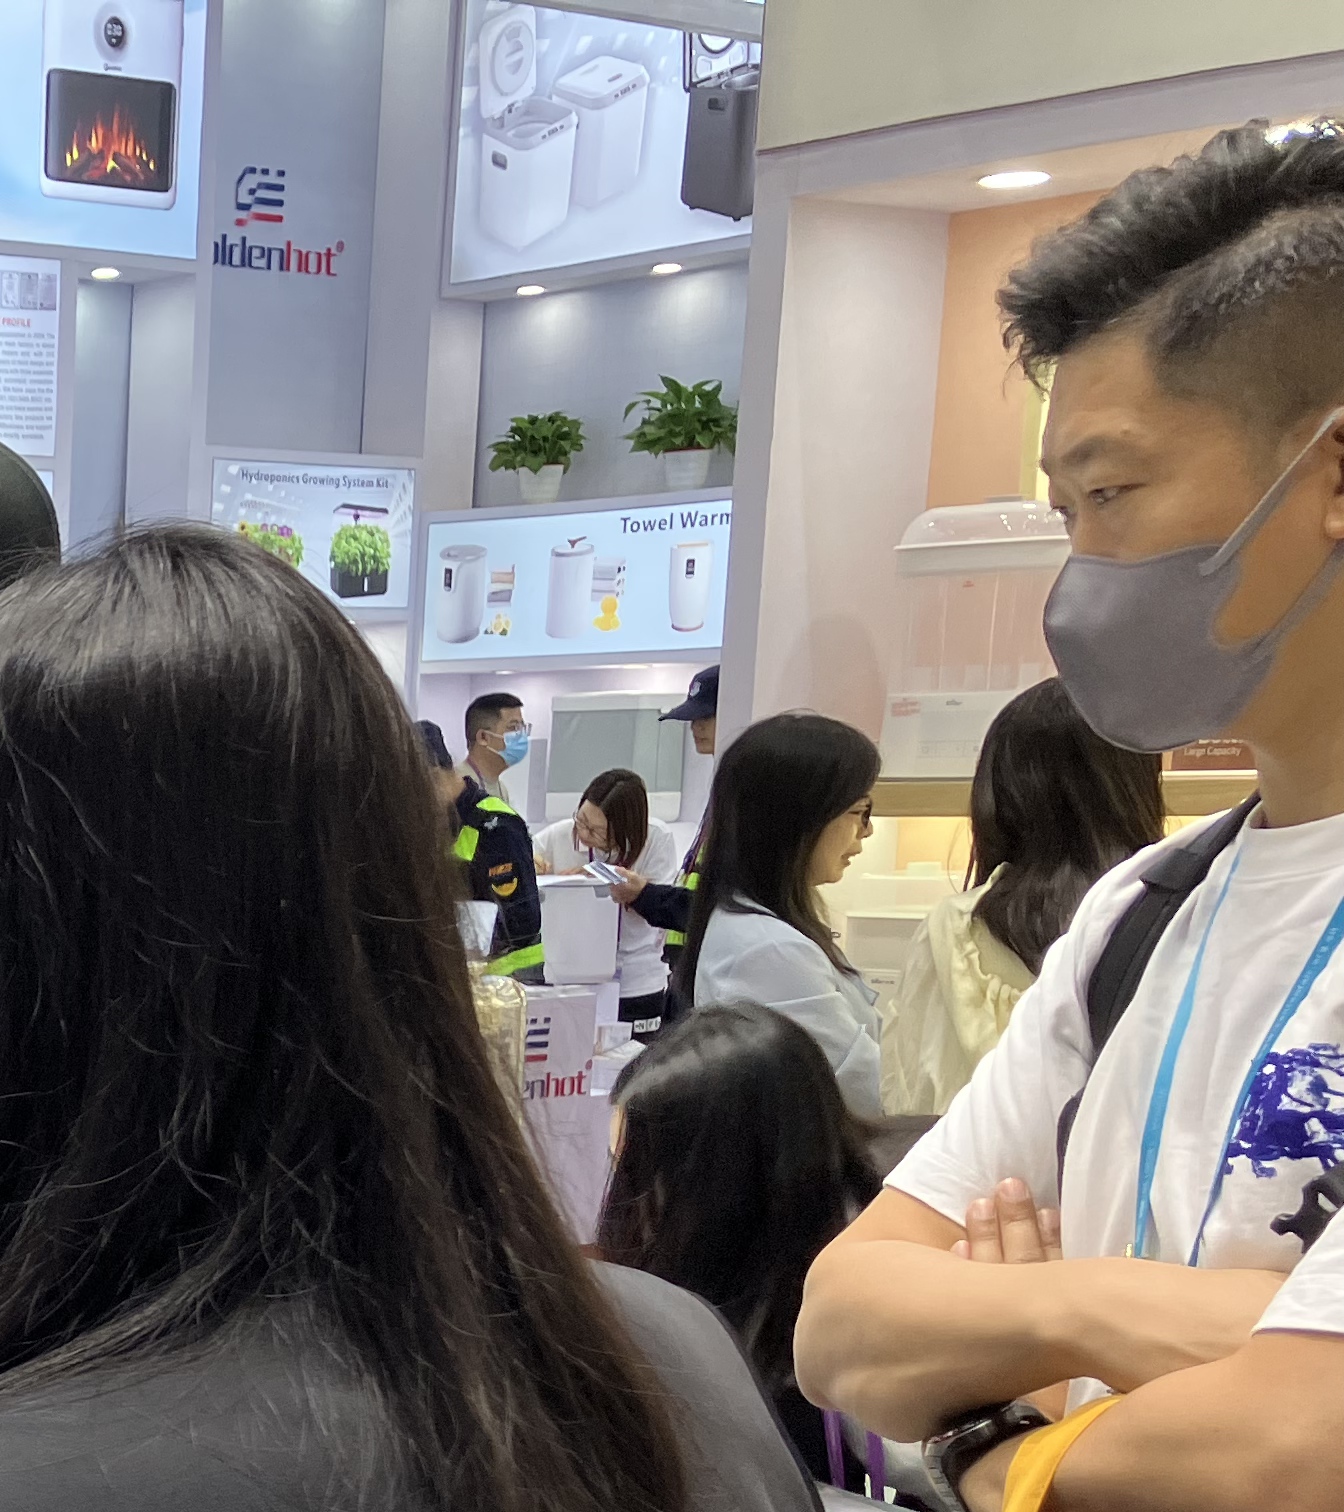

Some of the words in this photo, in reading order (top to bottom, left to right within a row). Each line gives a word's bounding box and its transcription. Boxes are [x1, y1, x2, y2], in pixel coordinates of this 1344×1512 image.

[1, 317, 31, 328] PROFILE
[241, 470, 300, 484] Hydroponics
[301, 473, 340, 489] Growing
[342, 475, 374, 489] System
[376, 478, 389, 489] Kit
[620, 512, 674, 534] Towel
[1183, 747, 1205, 759] Large
[1207, 747, 1241, 757] Capacity
